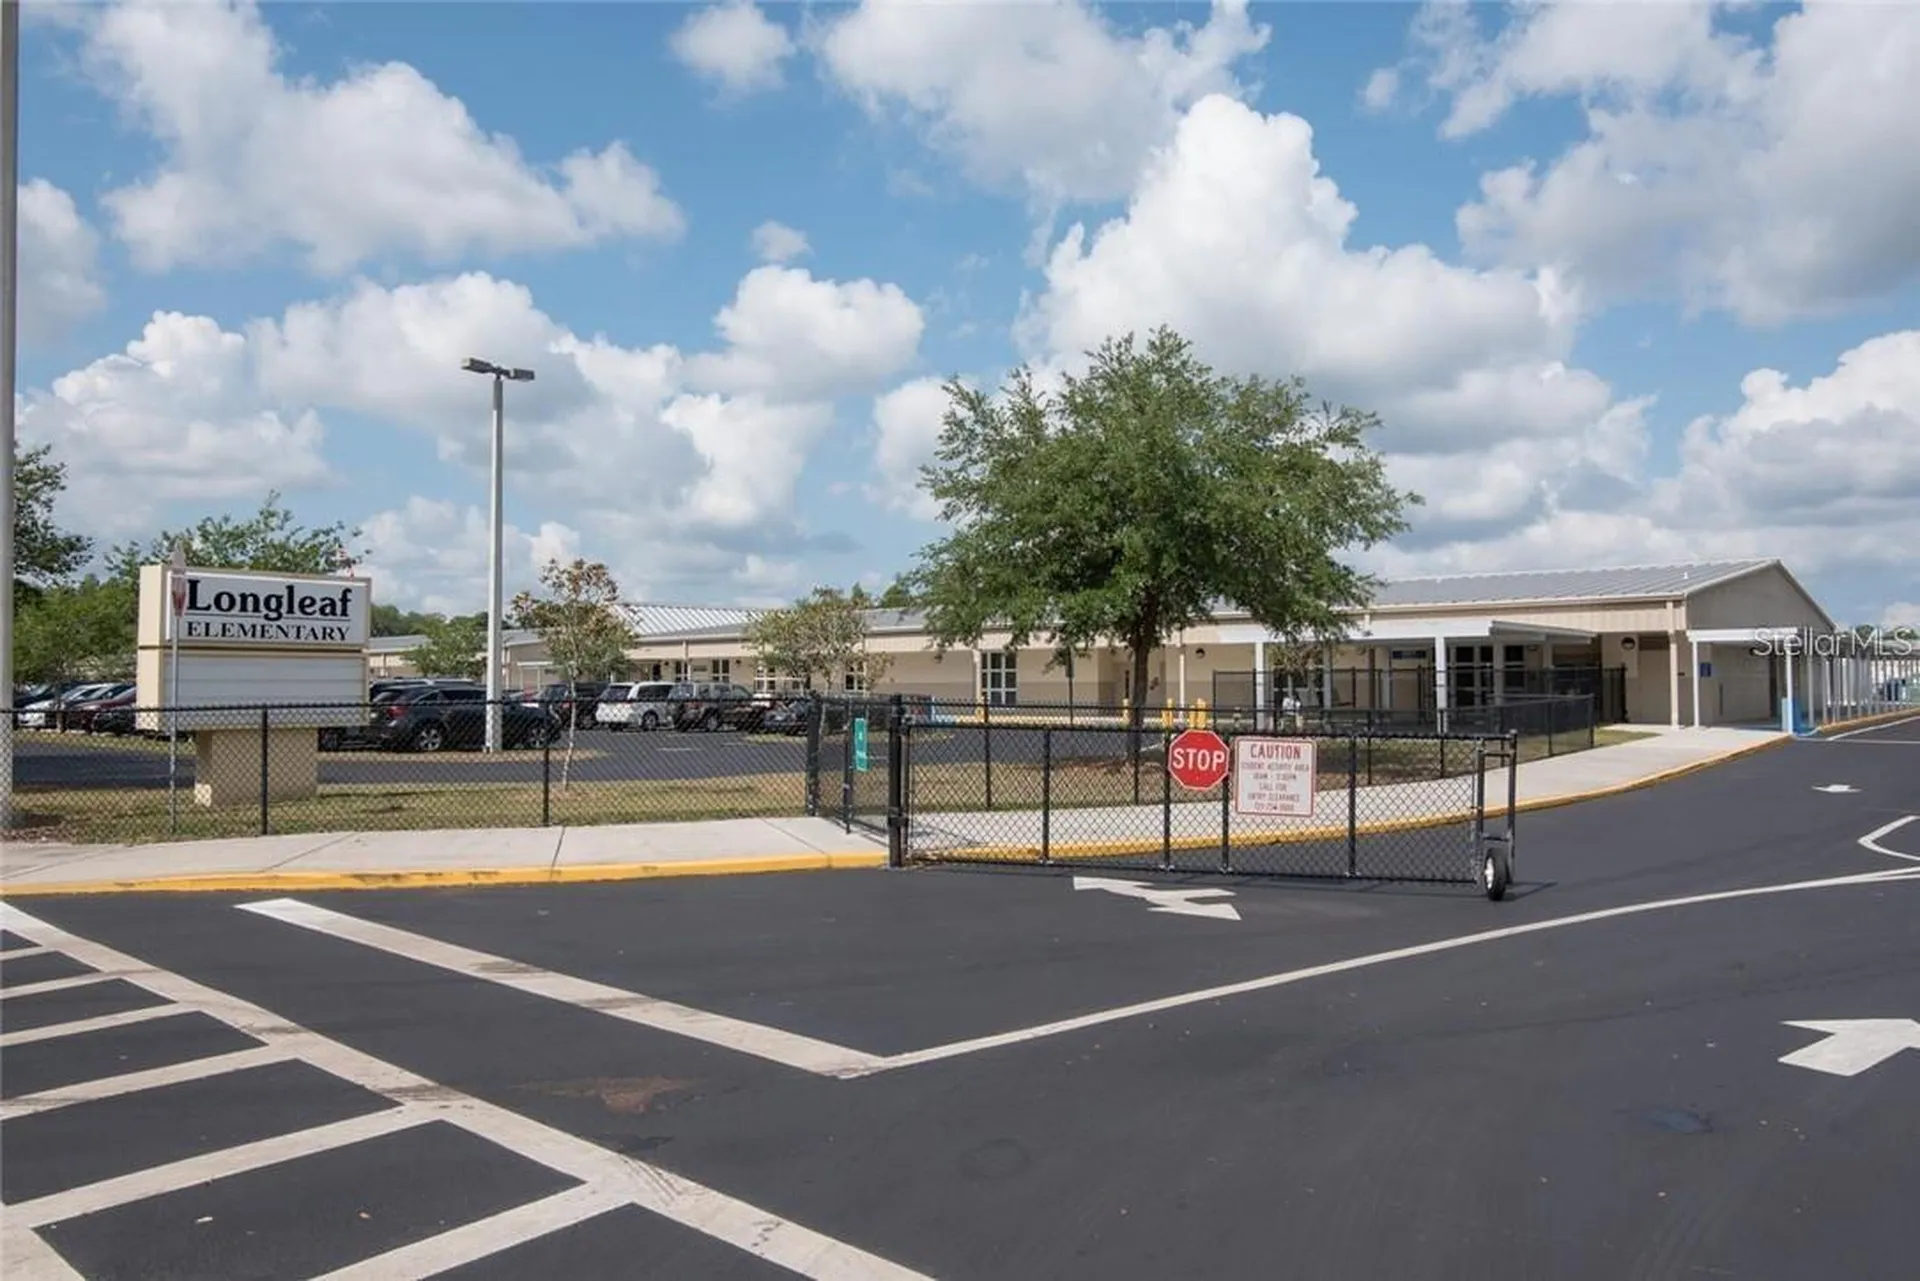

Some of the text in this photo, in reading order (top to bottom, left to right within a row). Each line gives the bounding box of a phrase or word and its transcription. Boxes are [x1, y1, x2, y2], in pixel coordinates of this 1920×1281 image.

[187, 579, 352, 621] Longleaf
[187, 621, 349, 641] ELEMENTARY
[1172, 748, 1226, 771] STOP
[1250, 743, 1301, 759] CAUTION
